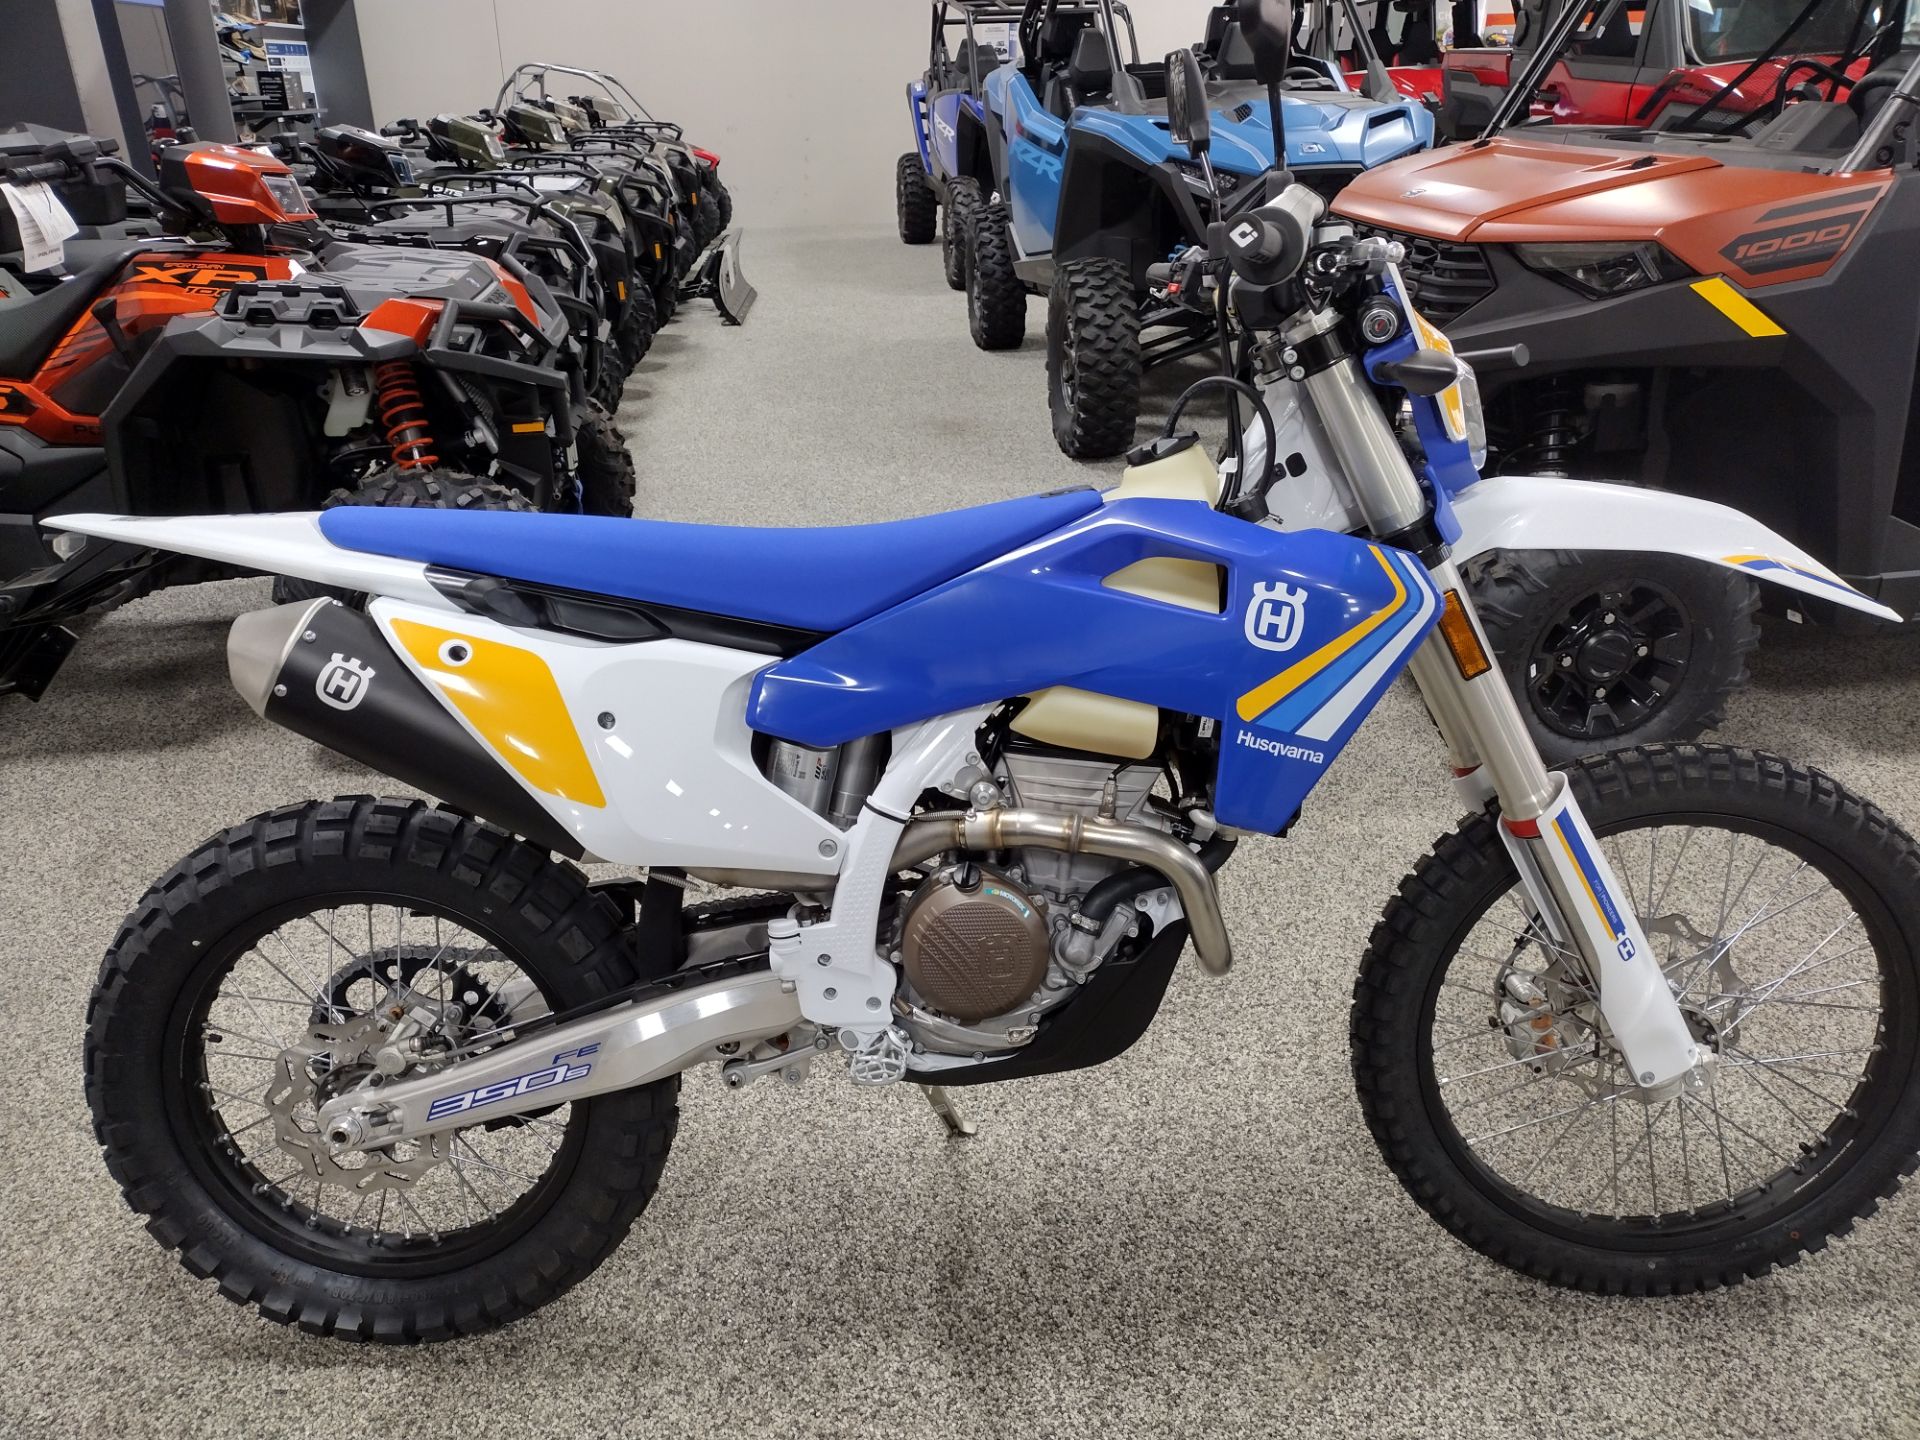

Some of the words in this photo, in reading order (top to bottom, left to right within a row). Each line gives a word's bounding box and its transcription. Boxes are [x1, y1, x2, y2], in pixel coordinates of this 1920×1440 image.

[1734, 224, 1850, 260] 1000
[123, 266, 257, 285] XP
[163, 262, 225, 270] SPORTSMAN
[1236, 729, 1325, 765] Husqvarna
[552, 1041, 602, 1065] FE
